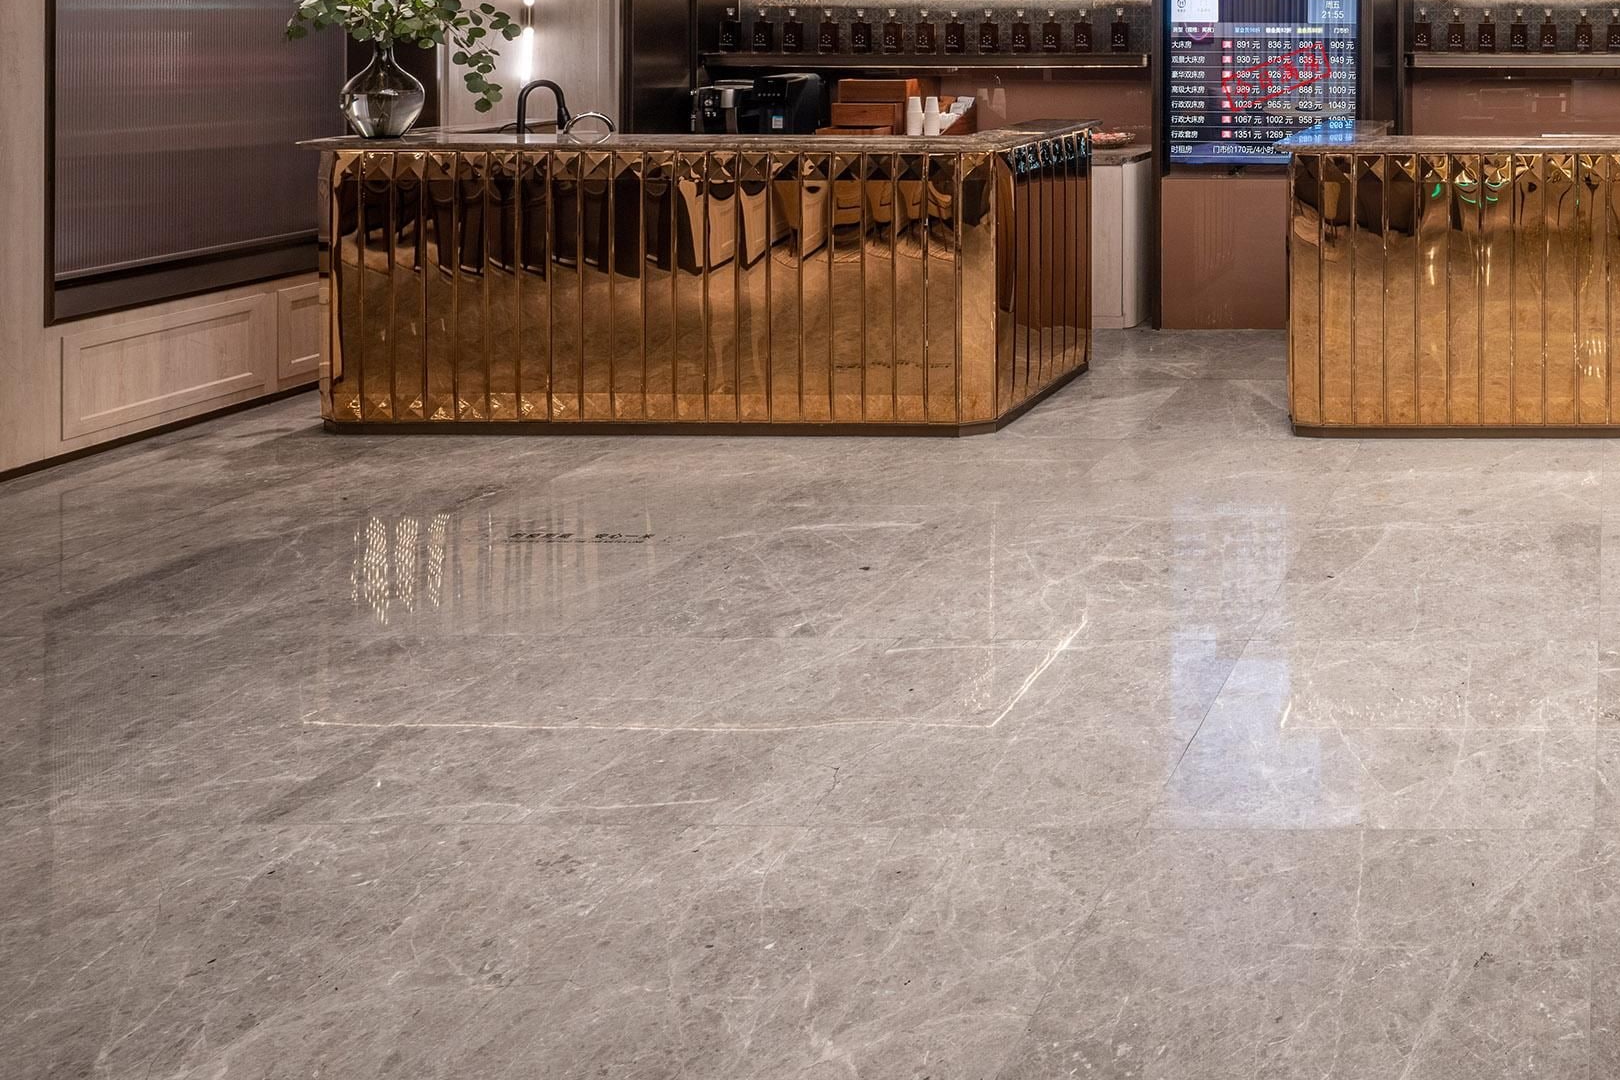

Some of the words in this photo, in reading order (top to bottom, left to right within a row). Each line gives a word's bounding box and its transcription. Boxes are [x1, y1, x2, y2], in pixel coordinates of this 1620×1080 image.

[1325, 1, 1340, 9] 周五
[1321, 11, 1345, 19] 21:55
[1171, 41, 1192, 49] 大床房
[1252, 41, 1261, 49] 元
[1283, 41, 1292, 49] 元
[1315, 41, 1323, 49] 元
[1346, 41, 1354, 49] 元
[1236, 56, 1250, 64] 930
[1252, 56, 1261, 64] 元
[1267, 56, 1282, 64] 873
[1283, 56, 1292, 64] 元
[1298, 56, 1313, 64] 835
[1315, 56, 1323, 64] 元
[1330, 56, 1344, 64] 949
[1346, 56, 1354, 64] 元
[1252, 71, 1261, 79] 元
[1283, 71, 1292, 79] 元
[1298, 71, 1313, 79] 888
[1315, 71, 1323, 79] 元
[1329, 71, 1346, 79] 1009
[1348, 71, 1356, 79] 元
[1171, 85, 1205, 94] 高级大床房
[1252, 85, 1261, 94] 元
[1267, 85, 1282, 94] 928
[1283, 85, 1292, 94] 元
[1298, 85, 1313, 94] 888
[1315, 85, 1323, 94] 元
[1329, 85, 1346, 94] 1009
[1348, 85, 1356, 94] 元
[1171, 101, 1205, 109] 行政双床房
[1254, 101, 1262, 109] 元
[1267, 101, 1282, 109] 965
[1283, 101, 1292, 109] 元
[1298, 101, 1313, 109] 923
[1315, 101, 1323, 109] 元
[1329, 101, 1346, 109] 1049
[1348, 101, 1356, 109] 元
[1171, 116, 1205, 124] 行政大床房
[1234, 116, 1252, 124] 1067
[1254, 116, 1262, 124] 元
[1266, 116, 1283, 124] 1002
[1285, 116, 1293, 124] 元
[1298, 116, 1313, 124] 958
[1315, 116, 1323, 124] 元
[1171, 131, 1198, 139] 行政套房
[1254, 131, 1262, 139] 元
